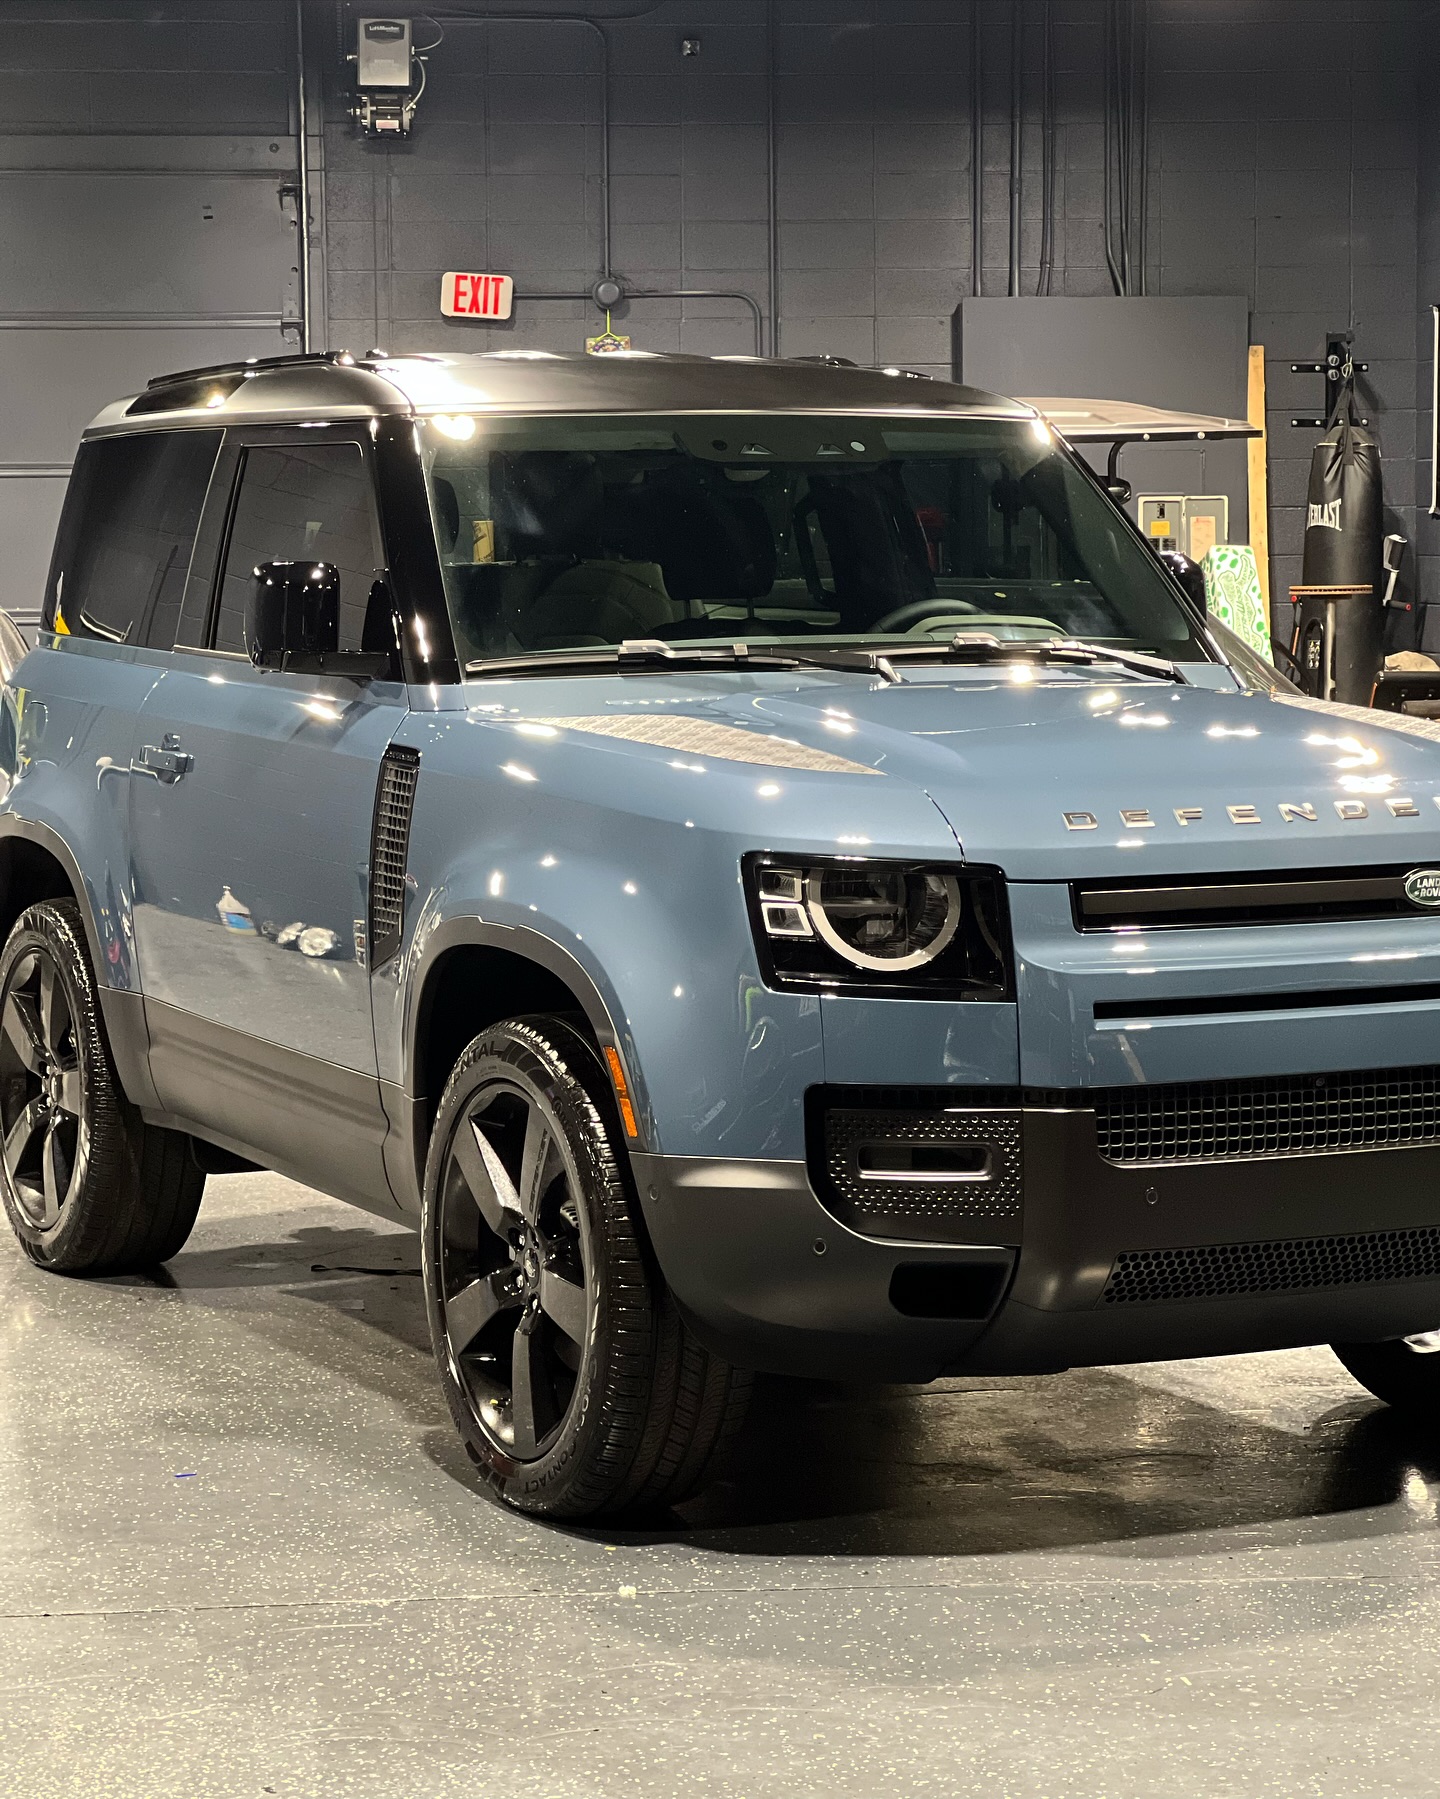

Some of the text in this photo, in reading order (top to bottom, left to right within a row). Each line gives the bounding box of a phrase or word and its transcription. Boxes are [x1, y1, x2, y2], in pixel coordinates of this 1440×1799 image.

[453, 274, 504, 315] EXIT
[1061, 796, 1440, 831] DEFENDE
[1420, 887, 1440, 897] ROV
